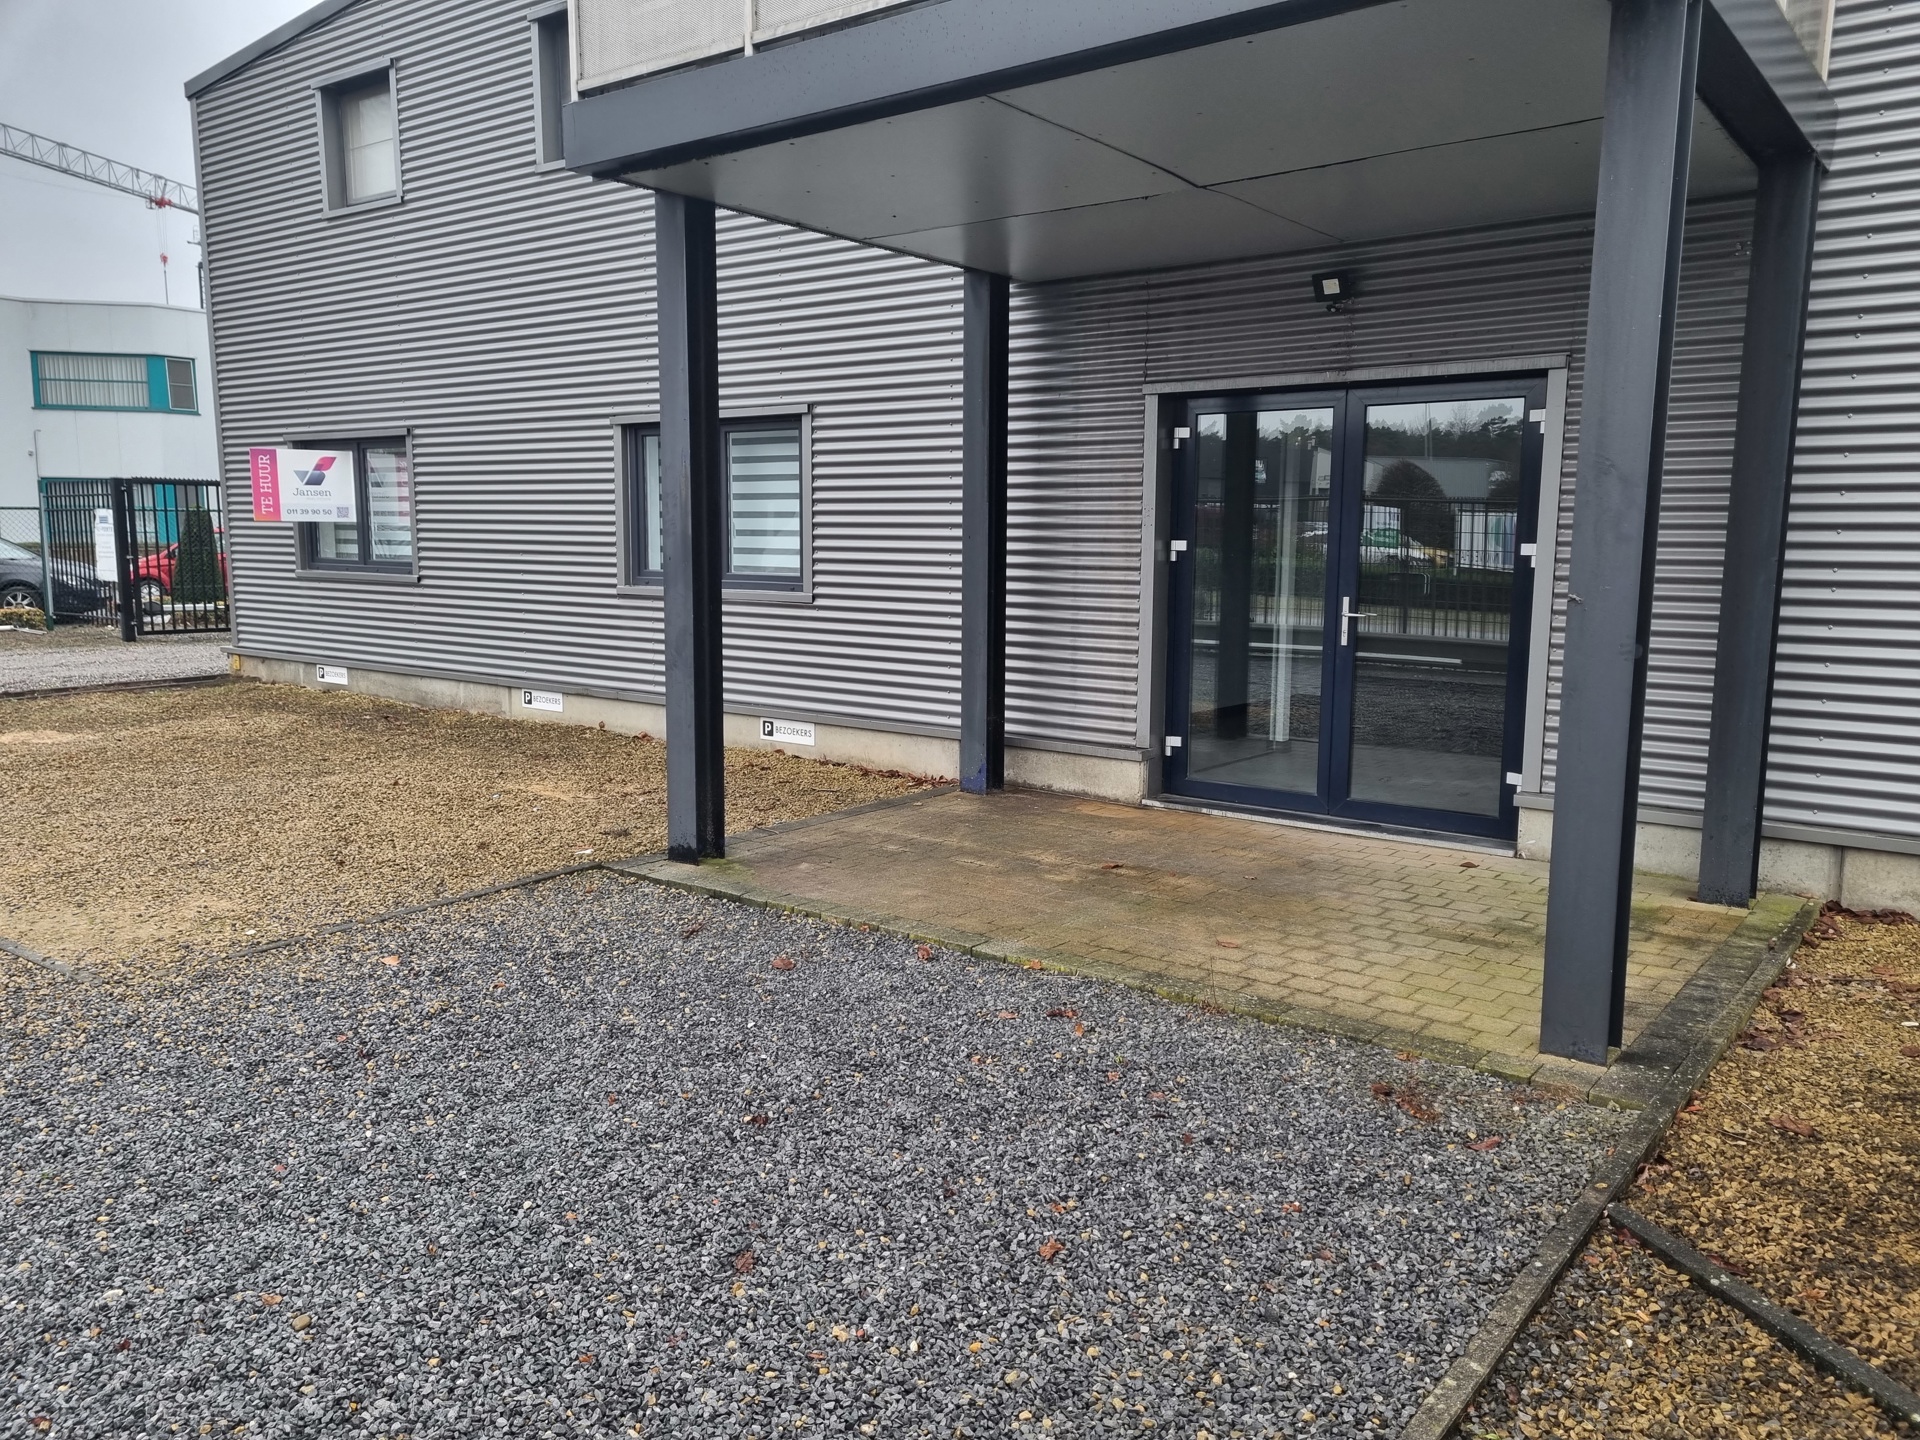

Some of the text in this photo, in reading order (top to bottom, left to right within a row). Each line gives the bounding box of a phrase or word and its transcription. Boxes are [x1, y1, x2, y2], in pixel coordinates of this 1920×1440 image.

[258, 454, 274, 514] TE HUUR
[292, 488, 332, 497] Jansen
[533, 695, 561, 705] BEZOEKERS
[765, 722, 812, 738] P BEZOEKERS
